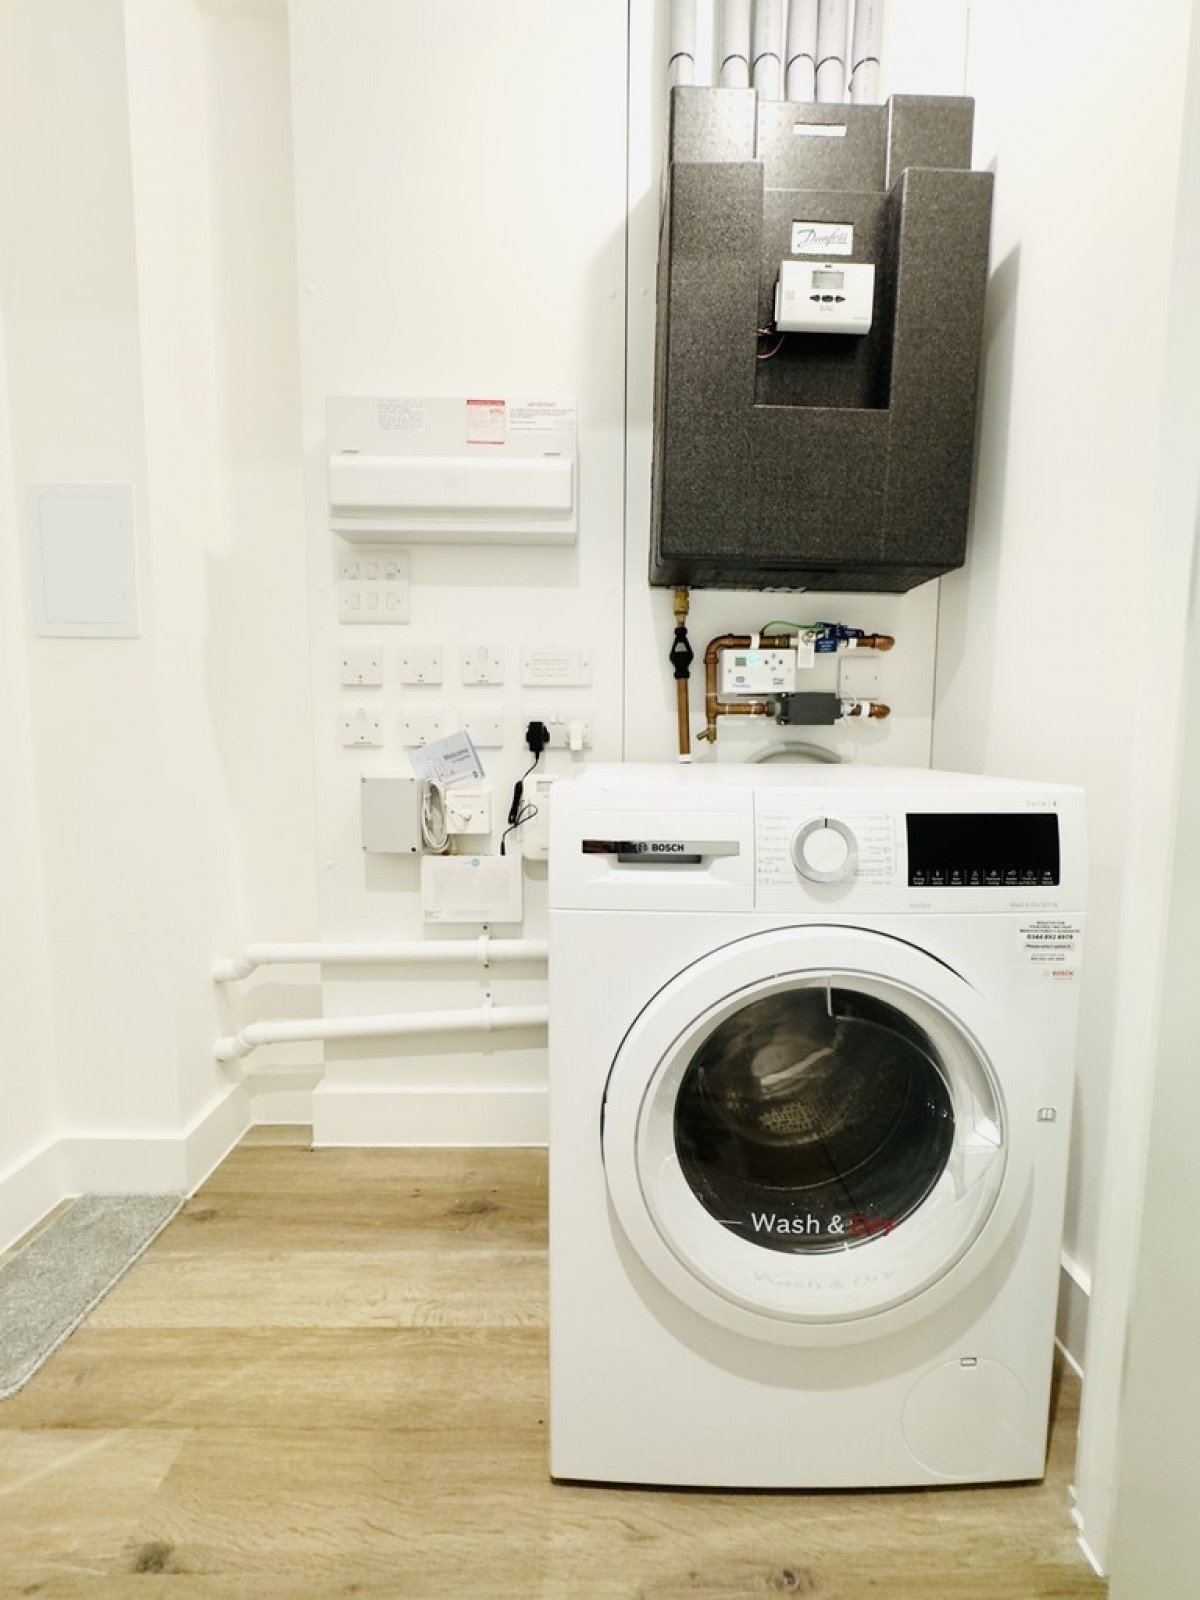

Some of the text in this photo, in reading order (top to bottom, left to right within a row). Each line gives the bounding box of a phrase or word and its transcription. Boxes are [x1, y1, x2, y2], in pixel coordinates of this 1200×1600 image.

[796, 226, 849, 248] Danfoss
[651, 843, 684, 852] BOSCH
[750, 1212, 820, 1234] Wash
[827, 1213, 845, 1234] &
